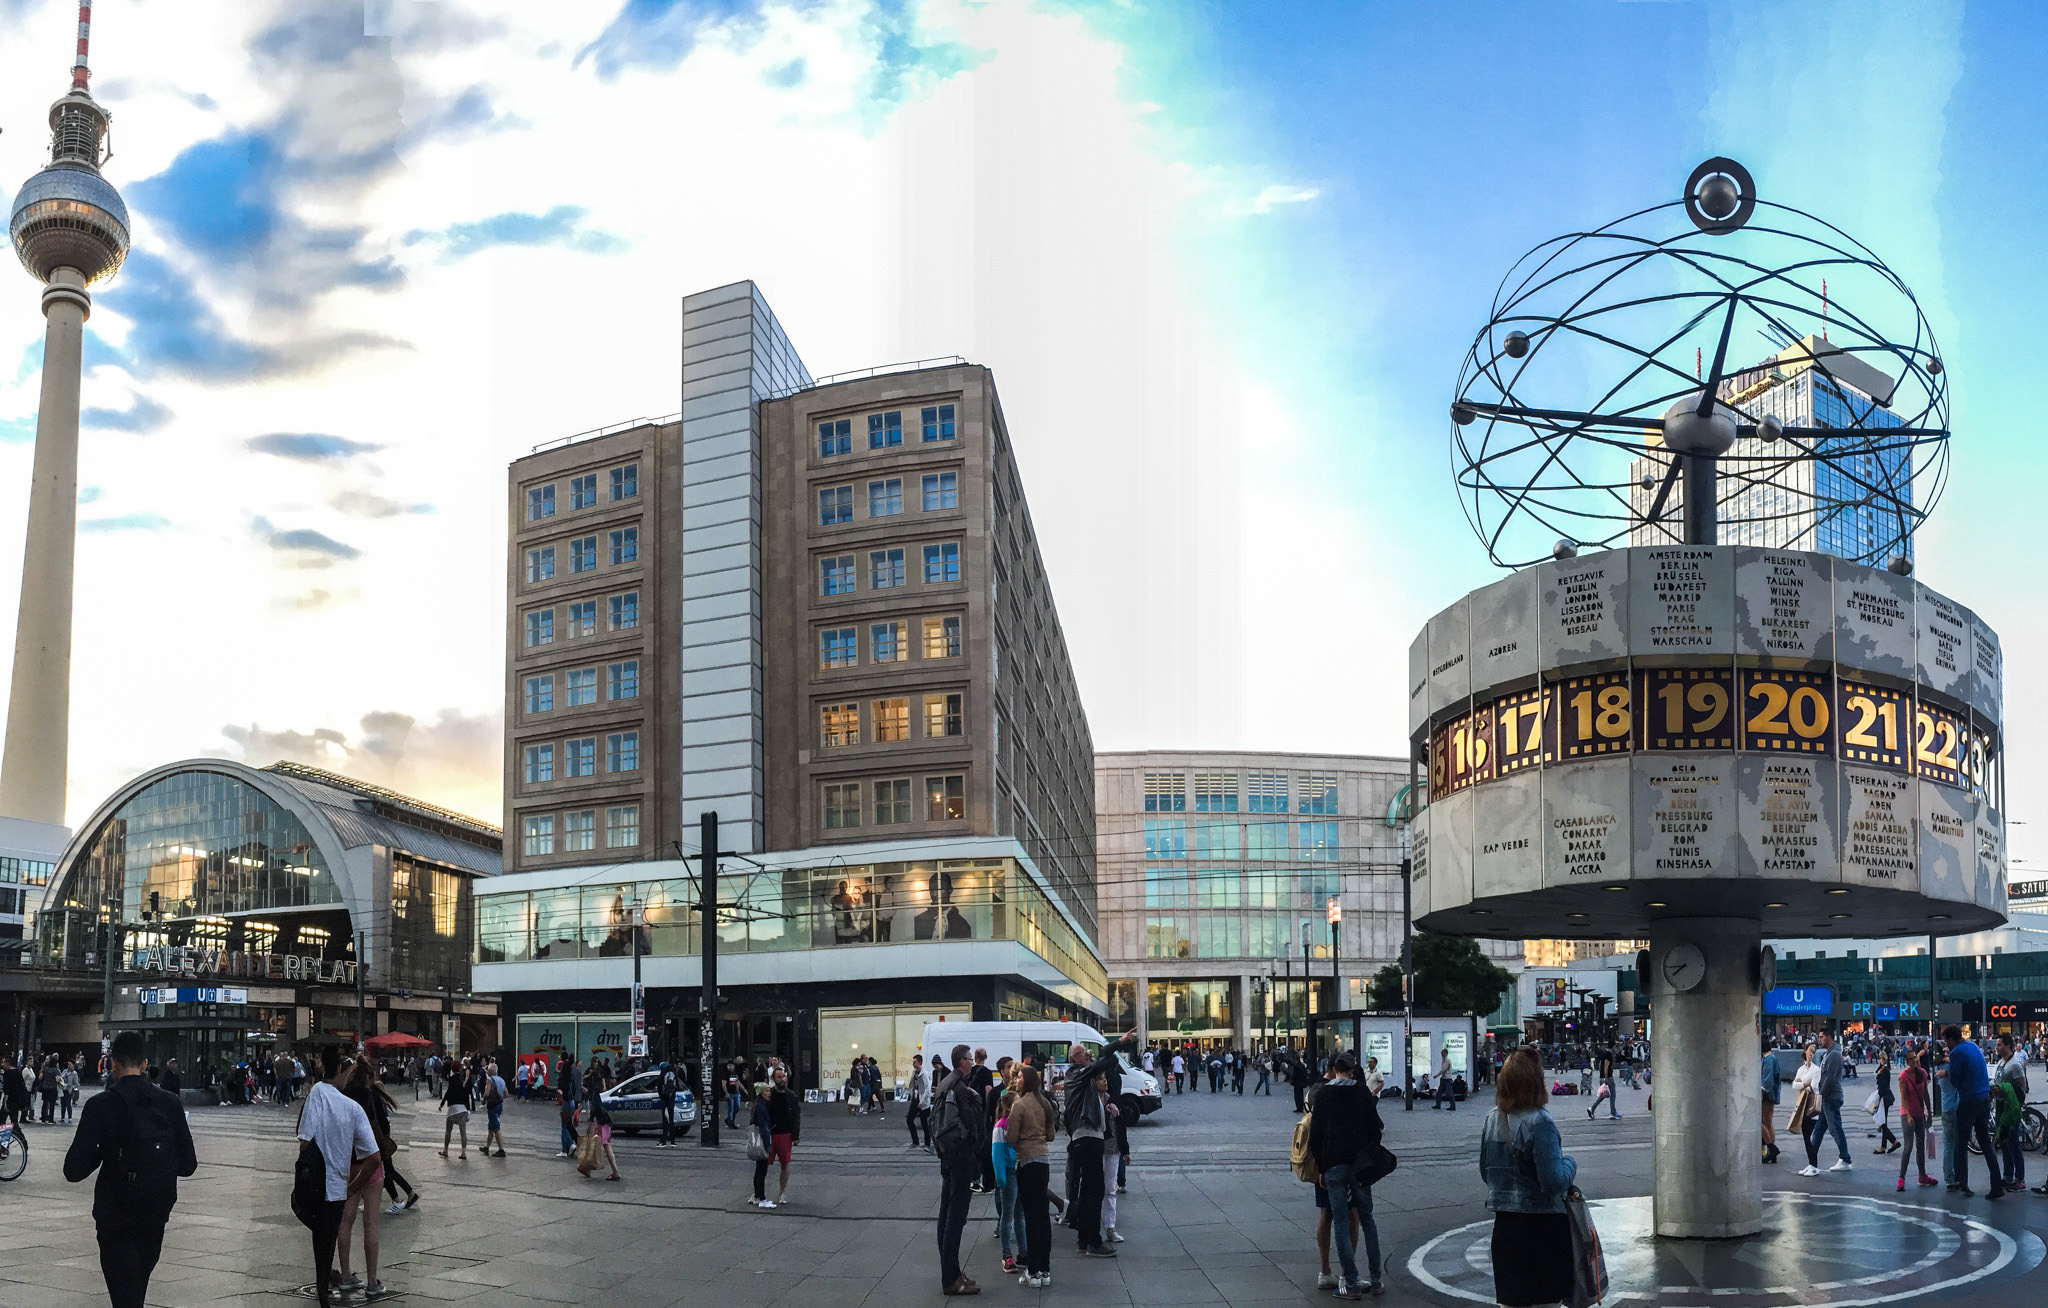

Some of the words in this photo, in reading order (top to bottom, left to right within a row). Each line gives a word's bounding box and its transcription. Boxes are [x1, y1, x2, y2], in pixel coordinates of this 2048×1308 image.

[1648, 551, 1713, 560] AMSTERDAM
[1763, 555, 1806, 568] HELSINKI
[1661, 562, 1699, 570] BERLIN
[1773, 567, 1796, 576] RIGA
[1558, 570, 1605, 586] REYKJAVIK
[1766, 576, 1804, 587] TALLINN
[1566, 582, 1597, 594] DUBLIN
[1653, 583, 1707, 591] BUDAPEST
[1770, 587, 1800, 597] WILNA
[1565, 592, 1599, 605] LONDON
[1658, 593, 1702, 602] MADRID
[1770, 598, 1800, 608] MINSK
[1853, 590, 1899, 609] MURMANSK
[1561, 601, 1603, 616] LISSABON
[1667, 604, 1696, 613] PARIS
[1774, 608, 1797, 617] KIEW
[1846, 600, 1857, 610] ST.
[1858, 603, 1905, 620] PETERSBURG
[1561, 612, 1603, 626] MADEIRA
[1667, 615, 1695, 624] PRAG
[1761, 617, 1810, 629] BUKAREST
[1860, 613, 1893, 627] MOSKAU
[1567, 623, 1598, 636] BISSAU
[1650, 626, 1713, 635] STOCKHOLM
[1771, 629, 1799, 639] SOFIA
[1652, 637, 1712, 646] WARSCHAU
[1766, 640, 1805, 650] NIKOSIA
[1938, 639, 1953, 652] BAKU
[1489, 642, 1517, 658] AZOREN
[1570, 685, 1632, 741] 18
[1658, 682, 1729, 734] 19
[1748, 682, 1830, 738] 20
[1500, 698, 1551, 756] 17
[1845, 695, 1898, 750] 21
[1917, 712, 1957, 770] 22
[1453, 720, 1487, 775] 16
[1767, 766, 1811, 776] ANKARA
[1650, 776, 1719, 786] KOPENHAGEN
[1765, 777, 1812, 787] ISTANBUL
[1850, 775, 1889, 788] TEHERAN
[1863, 788, 1896, 800] BAGDAD
[1869, 800, 1892, 811] ADEN
[1553, 814, 1616, 828] CASABLANCA
[1655, 811, 1713, 821] PRESSBURG
[1760, 811, 1818, 822] JERUSALEM
[1865, 810, 1895, 822] SANAA
[1931, 812, 1951, 824] KABUL
[1661, 823, 1708, 833] BELGRAD
[1772, 824, 1806, 833] BEIRUT
[1853, 821, 1878, 832] ADDIS
[1881, 823, 1908, 835] ABEBA
[1932, 823, 1964, 838] MAURITIUS
[1568, 840, 1602, 851] DAKAR
[1673, 835, 1695, 844] ROM
[1762, 835, 1818, 846] DAMASKUS
[1853, 833, 1908, 846] MOGADISCHU
[1483, 843, 1499, 854] KAP
[1502, 838, 1529, 851] VERDE
[1669, 847, 1700, 857] TUNIS
[1853, 844, 1909, 857] DARESSALAM
[1565, 851, 1606, 864] BAMAKO
[1775, 847, 1805, 858] KAIRO
[1656, 859, 1712, 869] KINSHASA
[1764, 860, 1816, 870] KAPSTADT
[1848, 854, 1914, 870] ANTANANARIVO
[1570, 864, 1602, 875] ACCRA
[1866, 868, 1897, 879] KUWAIT
[144, 944, 370, 985] ALEXANDERPLAT
[140, 990, 148, 1004] U
[198, 987, 206, 1001] U
[1793, 989, 1804, 1003] U
[1990, 1004, 2017, 1018] CCC
[540, 1028, 563, 1045] dm
[596, 1028, 621, 1045] dm
[823, 1069, 841, 1079] Duft
[624, 1101, 653, 1109] POLIZEI
